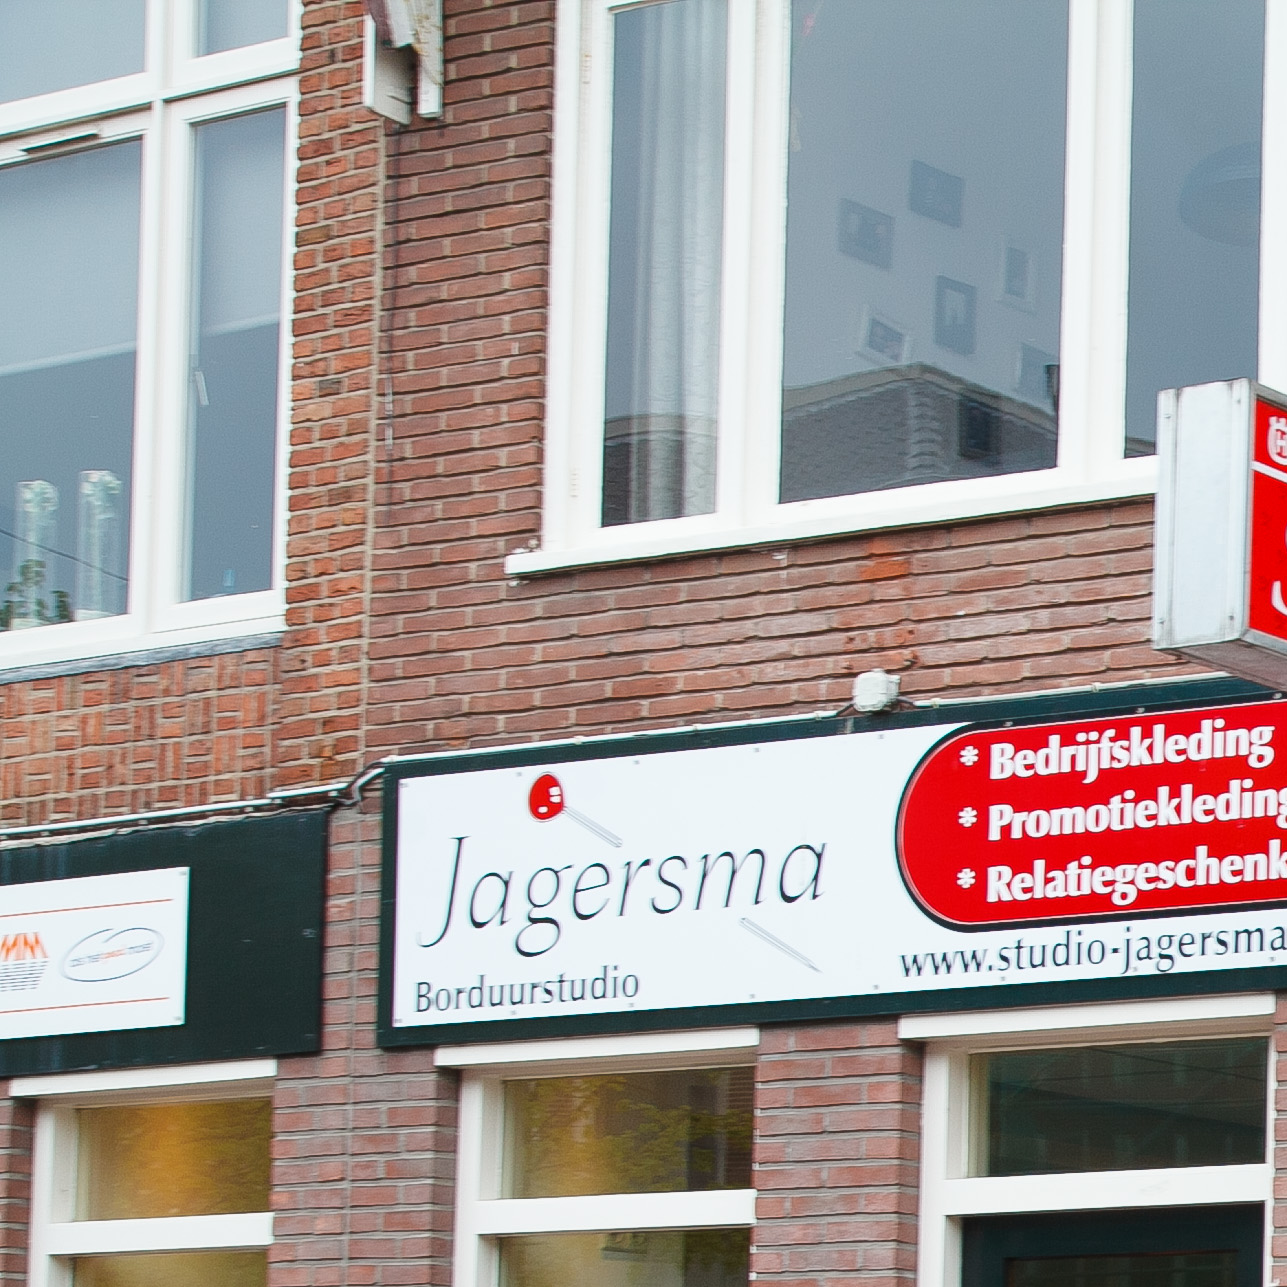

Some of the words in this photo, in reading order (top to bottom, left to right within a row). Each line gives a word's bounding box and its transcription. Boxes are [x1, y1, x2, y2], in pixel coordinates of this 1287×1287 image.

[989, 719, 1275, 783] Bedrijfskleding
[417, 836, 828, 957] Jagersma
[415, 965, 640, 1013] Borduurstudio
